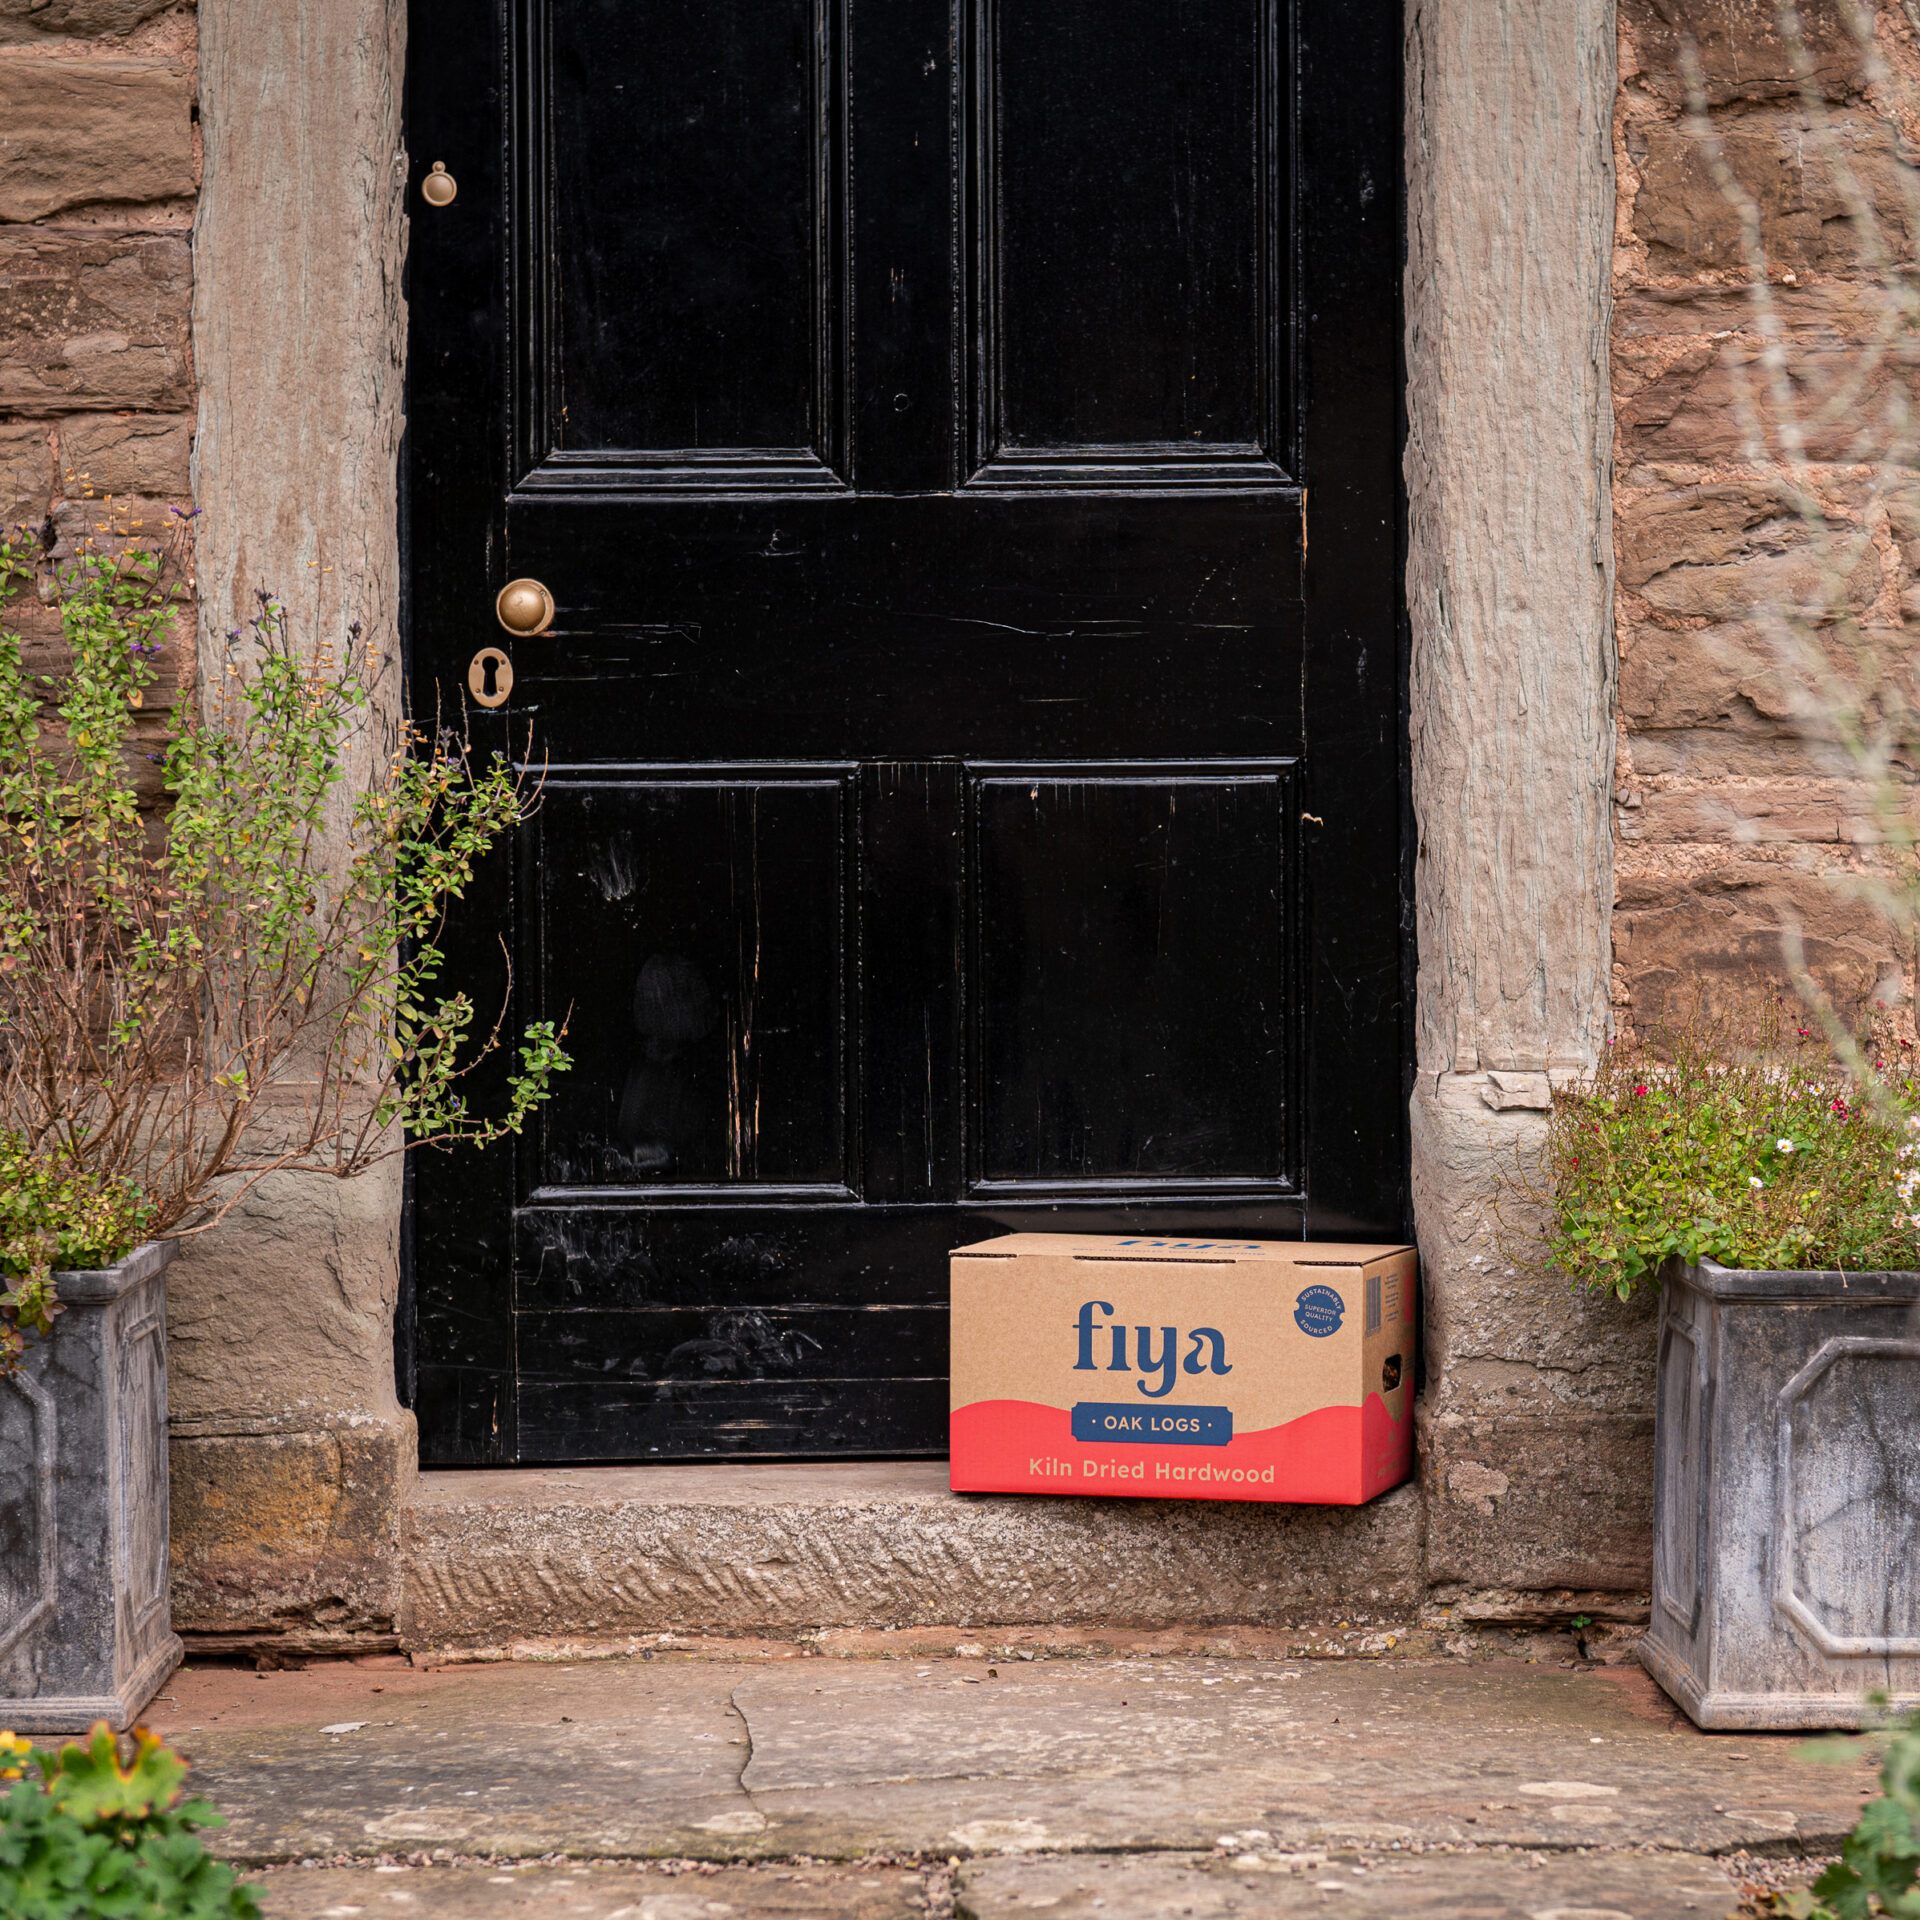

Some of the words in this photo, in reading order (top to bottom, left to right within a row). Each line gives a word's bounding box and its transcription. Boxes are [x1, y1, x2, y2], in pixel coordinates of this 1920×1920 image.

[1301, 1288, 1341, 1310] SUSTAINABLY
[1304, 1304, 1336, 1316] SUPERIOR
[1305, 1311, 1333, 1322] QUALITY
[1300, 1319, 1333, 1335] SOURCED
[1072, 1300, 1233, 1398] fiya
[1104, 1415, 1143, 1431] OAK
[1151, 1417, 1200, 1432] LOGS
[1029, 1457, 1072, 1476] Kiln
[1083, 1458, 1144, 1479] Dried
[1155, 1462, 1275, 1483] Hardwood
